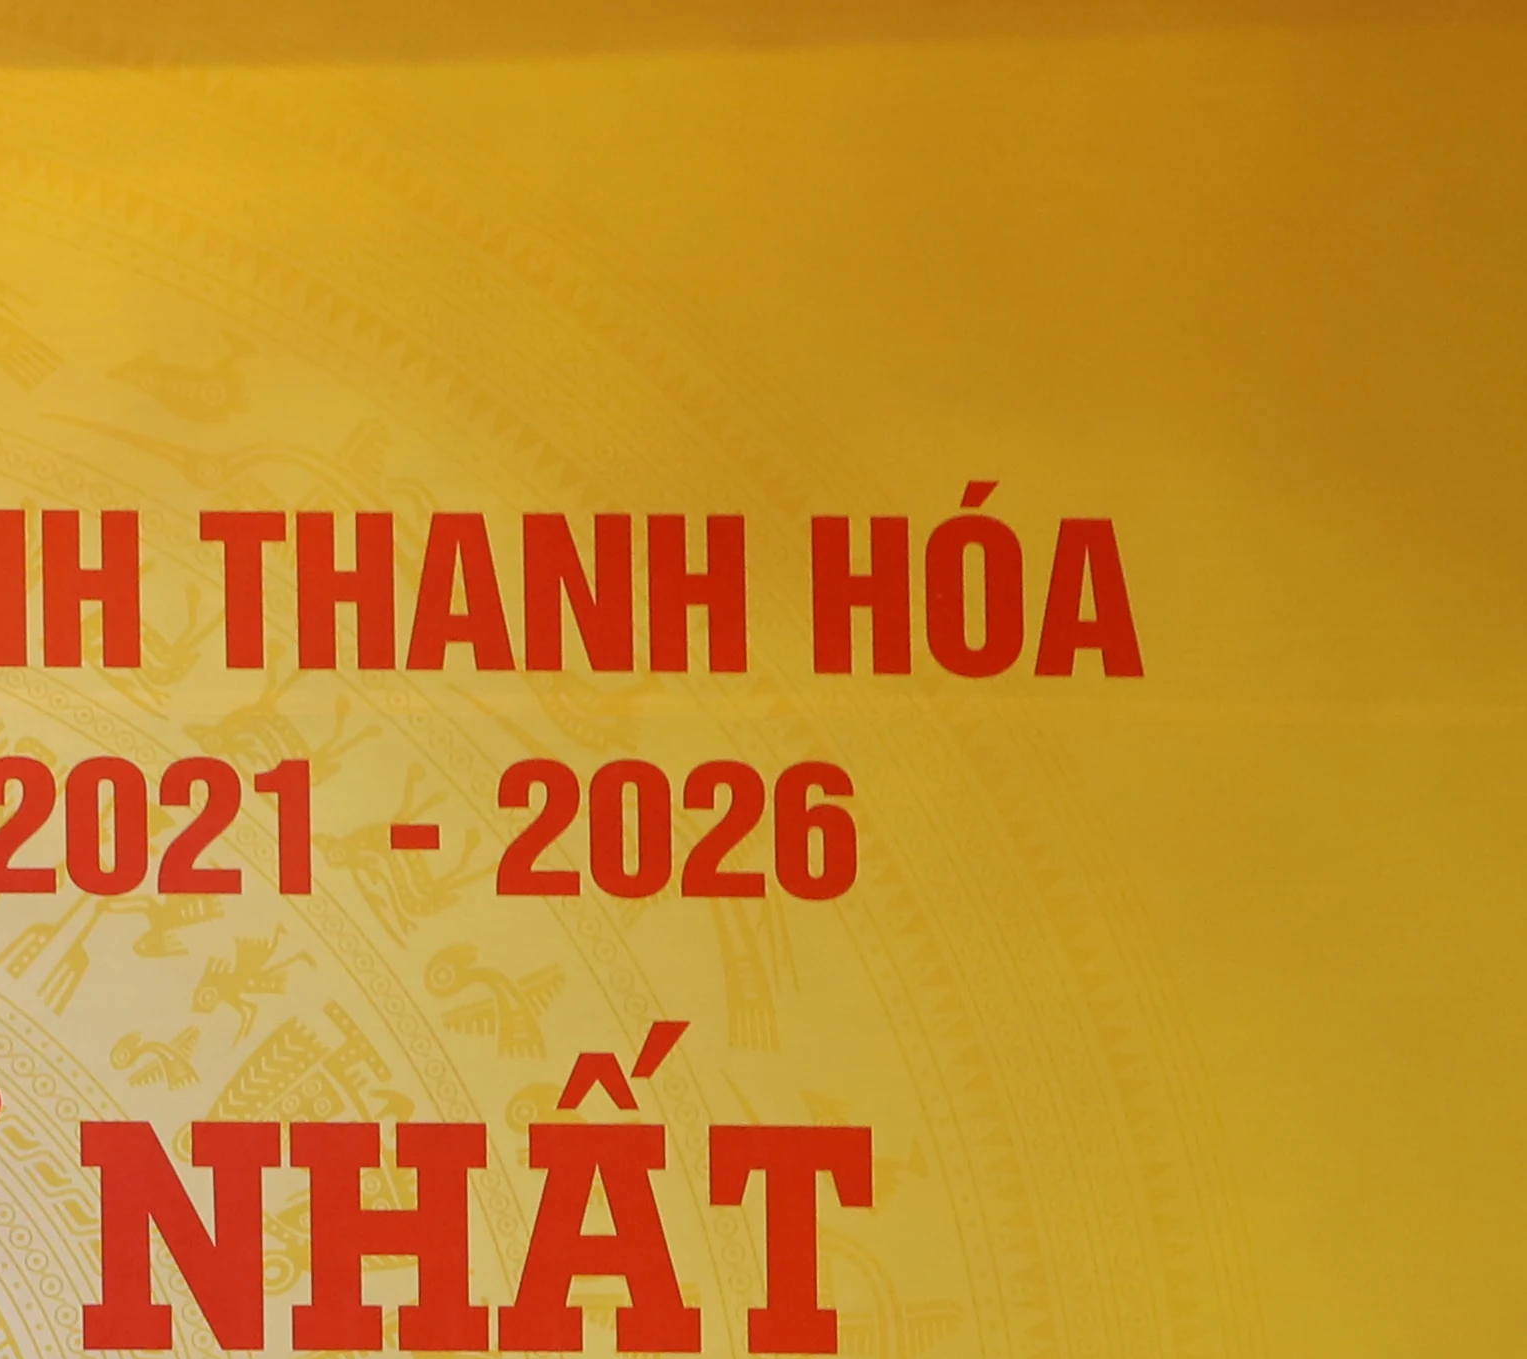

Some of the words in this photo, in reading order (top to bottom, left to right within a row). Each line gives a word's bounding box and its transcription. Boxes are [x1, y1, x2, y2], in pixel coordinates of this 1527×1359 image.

[198, 509, 750, 675] THANH
[809, 479, 1146, 680] HÓA
[389, 822, 441, 852] -
[495, 757, 859, 903] 2026
[80, 1019, 875, 1356] NHẤT
